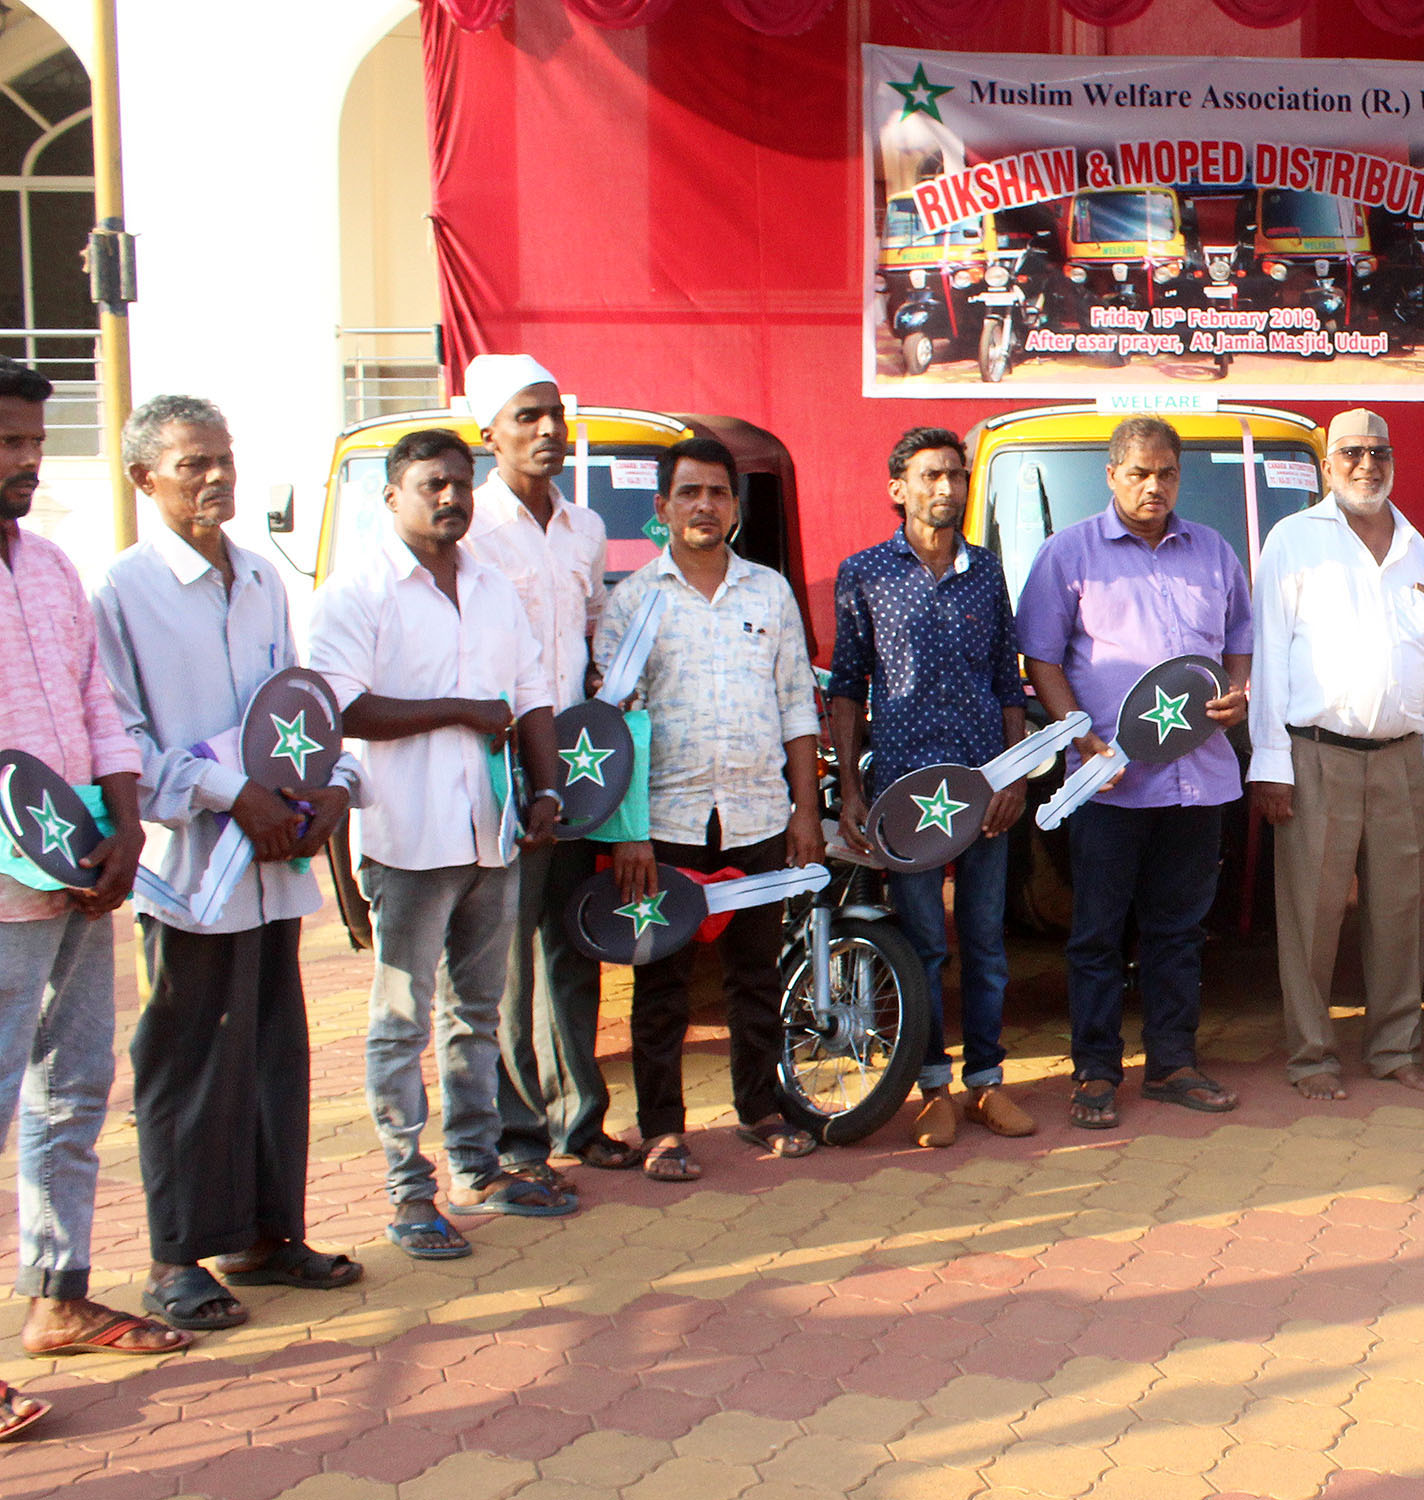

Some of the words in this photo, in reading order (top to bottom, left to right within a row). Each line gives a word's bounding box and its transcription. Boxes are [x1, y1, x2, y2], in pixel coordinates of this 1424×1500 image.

[969, 79, 1073, 106] Muslim
[1083, 83, 1192, 108] Welfare
[1200, 84, 1351, 113] Association
[1361, 88, 1411, 119] (R.)
[913, 147, 1077, 232] RIKSHAW
[1088, 152, 1113, 189] &
[1119, 140, 1245, 185] MOPED
[1092, 307, 1148, 331] Friday
[1189, 308, 1267, 331] February
[1270, 308, 1320, 331] 2019,
[1027, 330, 1073, 350] After
[1076, 334, 1116, 350] asar
[1119, 334, 1184, 355] prayer,
[1190, 332, 1214, 350] At
[1215, 332, 1266, 354] Jamia
[1270, 332, 1333, 355] Masjid,
[1336, 332, 1388, 355] Udupi
[1111, 395, 1201, 409] WELFARE
